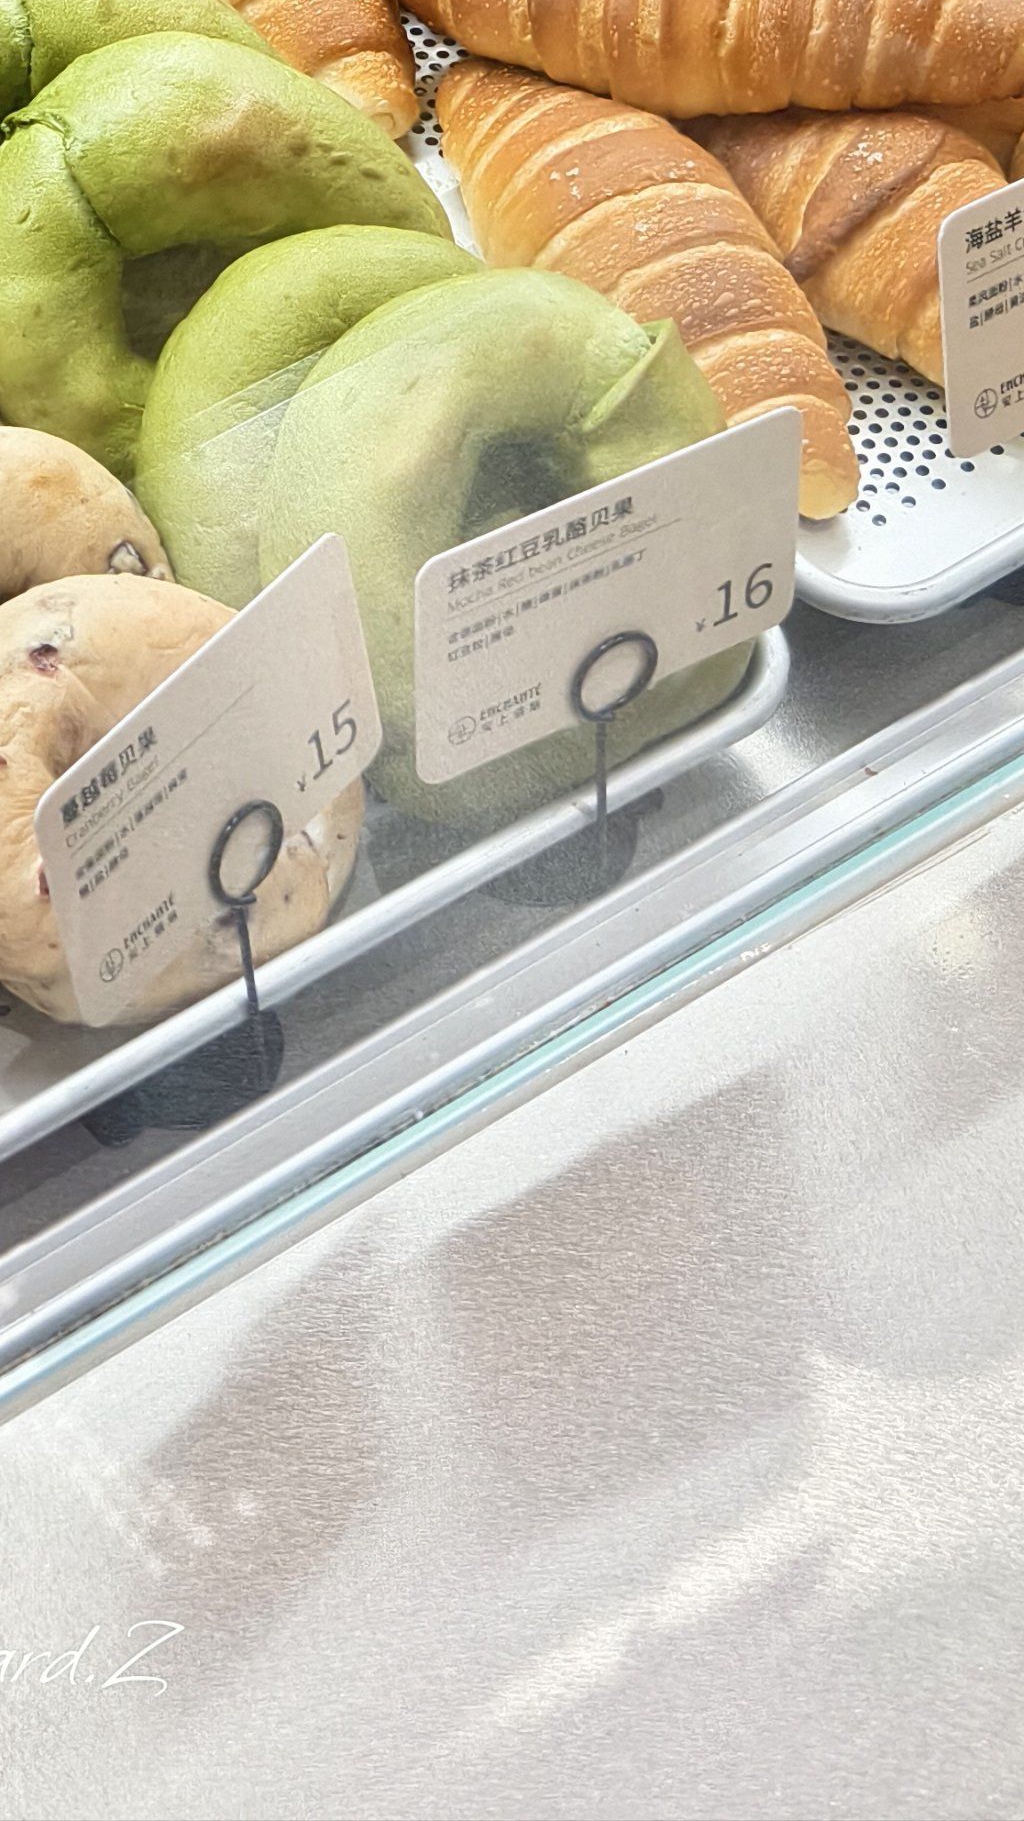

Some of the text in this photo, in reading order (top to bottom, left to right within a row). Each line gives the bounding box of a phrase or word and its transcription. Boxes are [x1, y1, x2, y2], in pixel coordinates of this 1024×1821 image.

[965, 207, 1024, 254] 海盐羊
[965, 257, 987, 275] Sea
[989, 243, 1012, 263] Salt
[447, 496, 634, 594] 抹茶红豆乳酪贝果
[61, 726, 157, 828] 蔓越莓贝果
